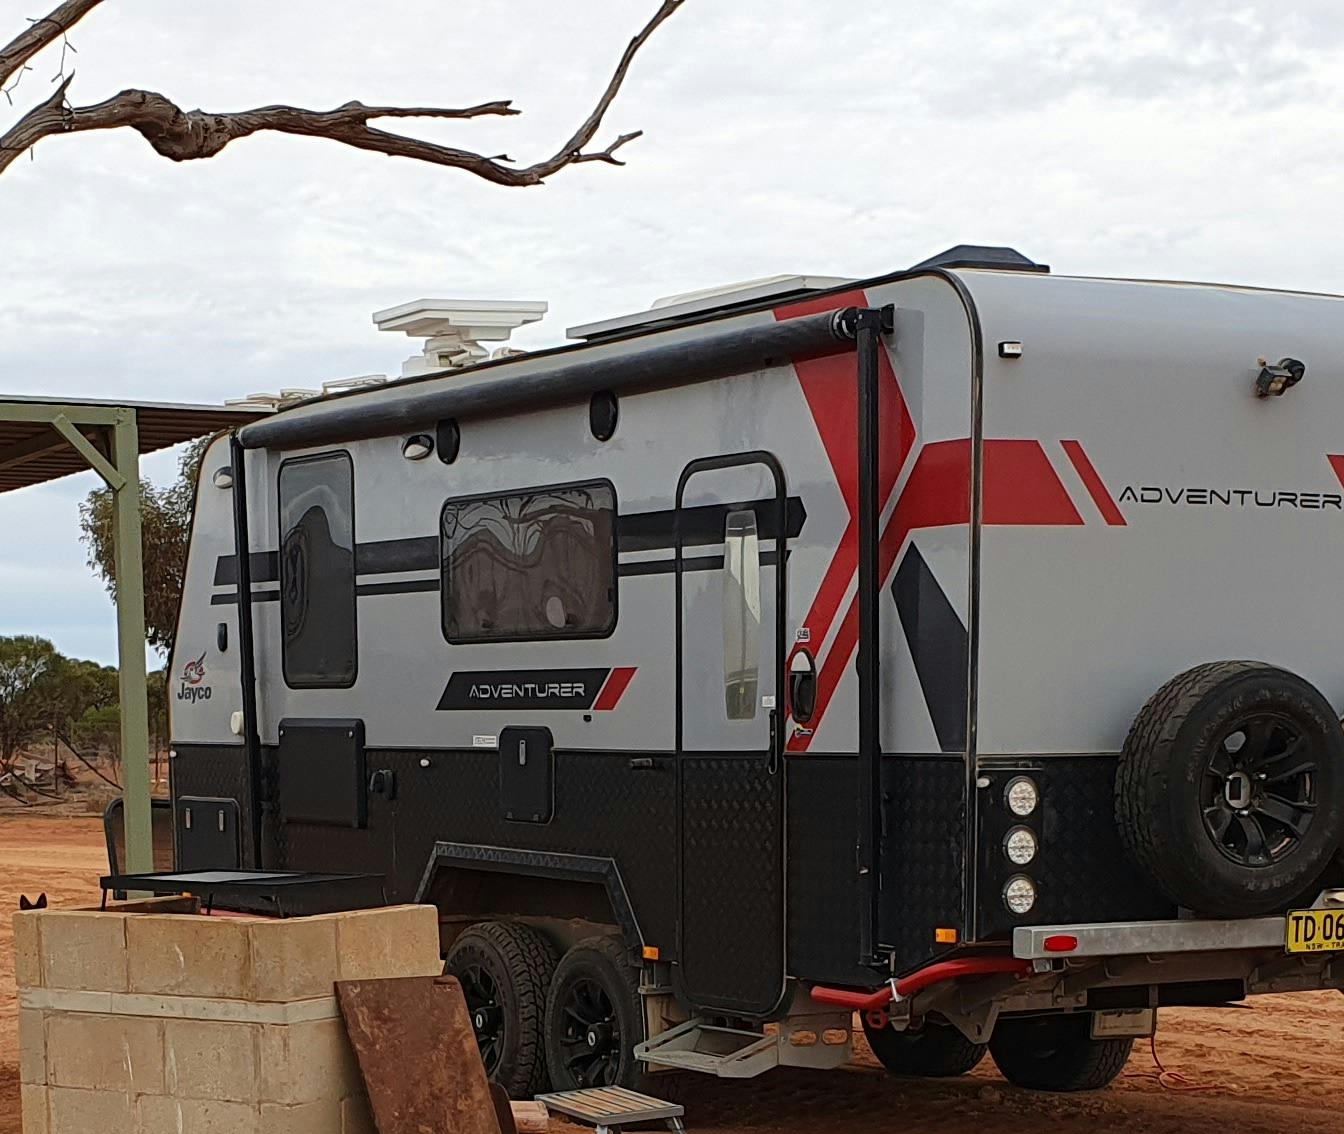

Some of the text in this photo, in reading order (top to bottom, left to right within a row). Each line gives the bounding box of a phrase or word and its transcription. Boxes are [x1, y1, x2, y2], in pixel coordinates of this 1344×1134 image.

[1119, 486, 1343, 510] ADVENTURER
[177, 682, 212, 704] Jayco
[469, 683, 585, 698] ADVENTURER
